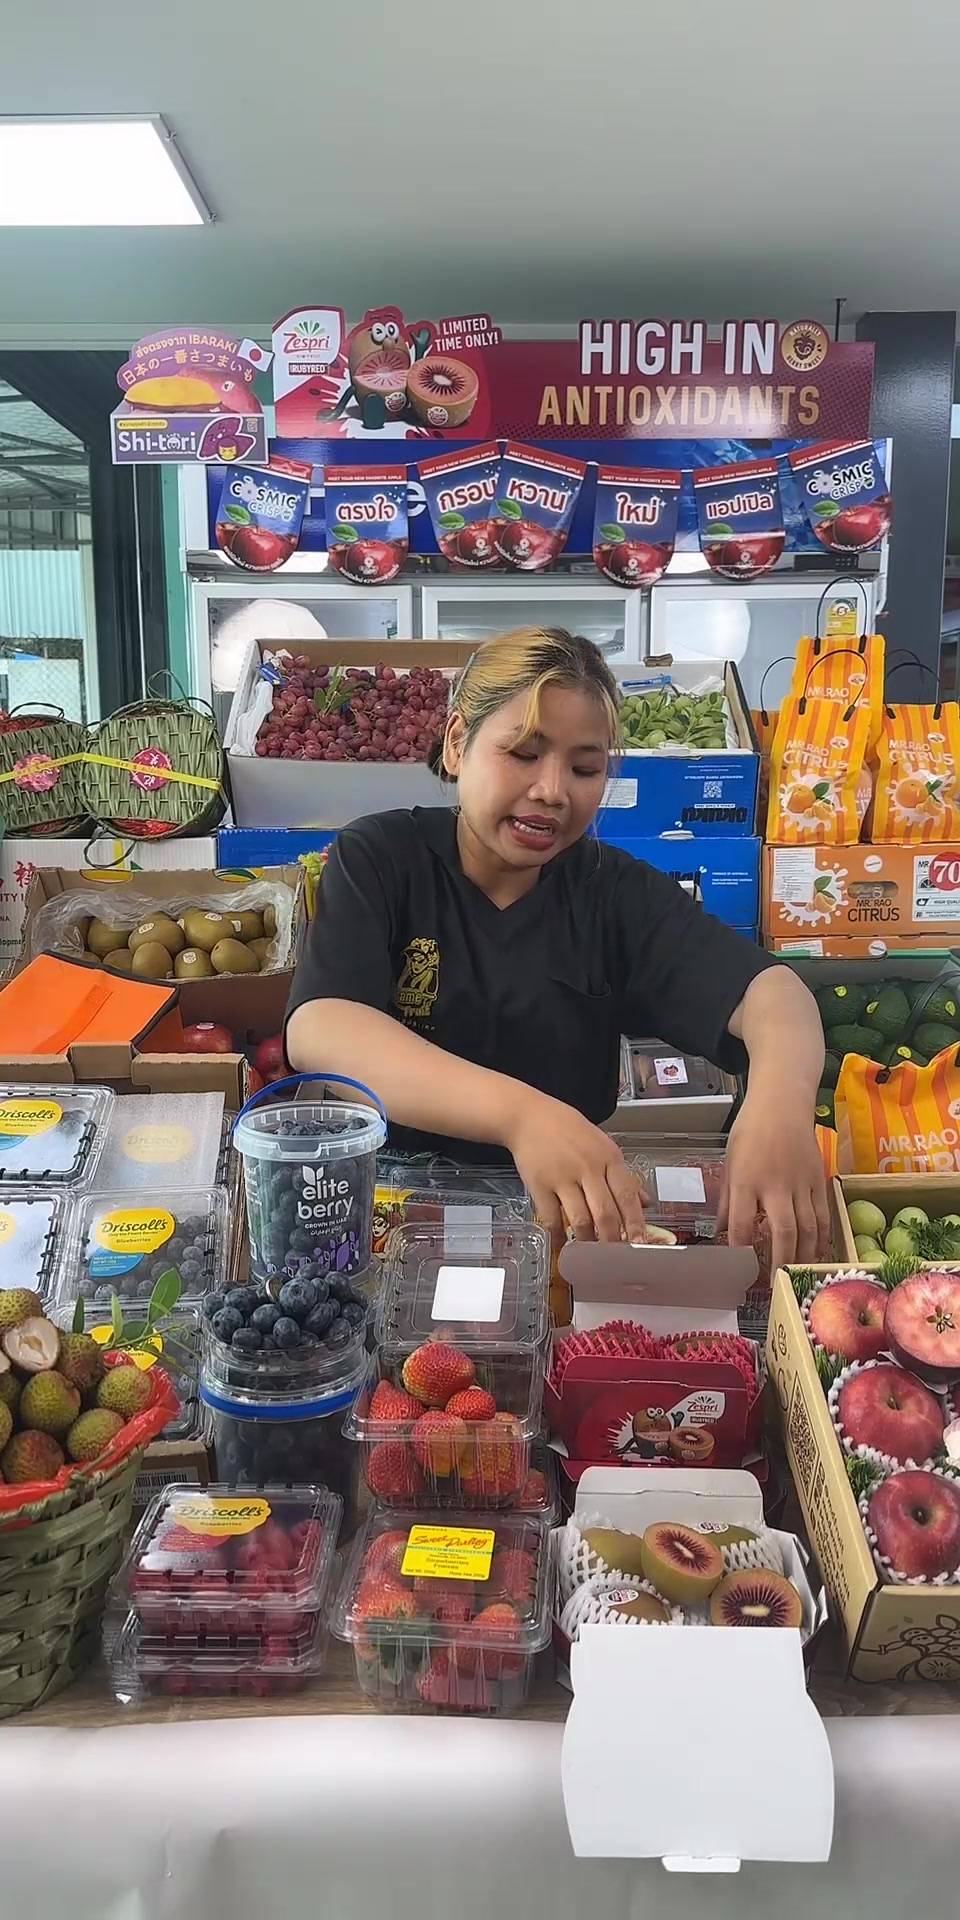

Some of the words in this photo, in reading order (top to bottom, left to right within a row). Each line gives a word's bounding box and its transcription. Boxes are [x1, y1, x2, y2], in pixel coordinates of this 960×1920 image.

[442, 317, 488, 336] LIMITED
[189, 334, 238, 354] IBARAKI
[283, 333, 331, 354] Zespri
[435, 335, 463, 352] TIME
[465, 331, 499, 348] ONLY!
[581, 322, 703, 375] HIGH
[724, 322, 776, 375] IN
[537, 385, 820, 426] ANTIOXIDANTS
[439, 479, 497, 511] กรอบ
[508, 479, 567, 512] หวาน
[830, 482, 860, 500] CRISP
[249, 501, 280, 518] CRISP
[338, 495, 396, 522] ตรงใจ
[616, 492, 660, 525] ใหม่
[707, 494, 772, 519] แอปเปิล
[807, 686, 849, 699] MR.RAO
[786, 740, 829, 757] MR.RAO
[889, 739, 931, 752] MR.RAO
[783, 750, 849, 770] CITRUS
[888, 751, 955, 766] CITRUS
[933, 860, 960, 884] 70
[856, 899, 872, 907] MR.
[873, 898, 892, 907] RAO
[847, 907, 900, 922] CITRUS
[878, 1128, 959, 1152] MR.RAO
[302, 1178, 349, 1200] elite
[297, 1195, 354, 1220] berry
[101, 1219, 168, 1233] Driscoll's
[687, 1401, 718, 1412] Zespri
[180, 1506, 264, 1517] Driscoll's
[412, 1534, 449, 1545] Sweet
[446, 1536, 488, 1549] Darling
